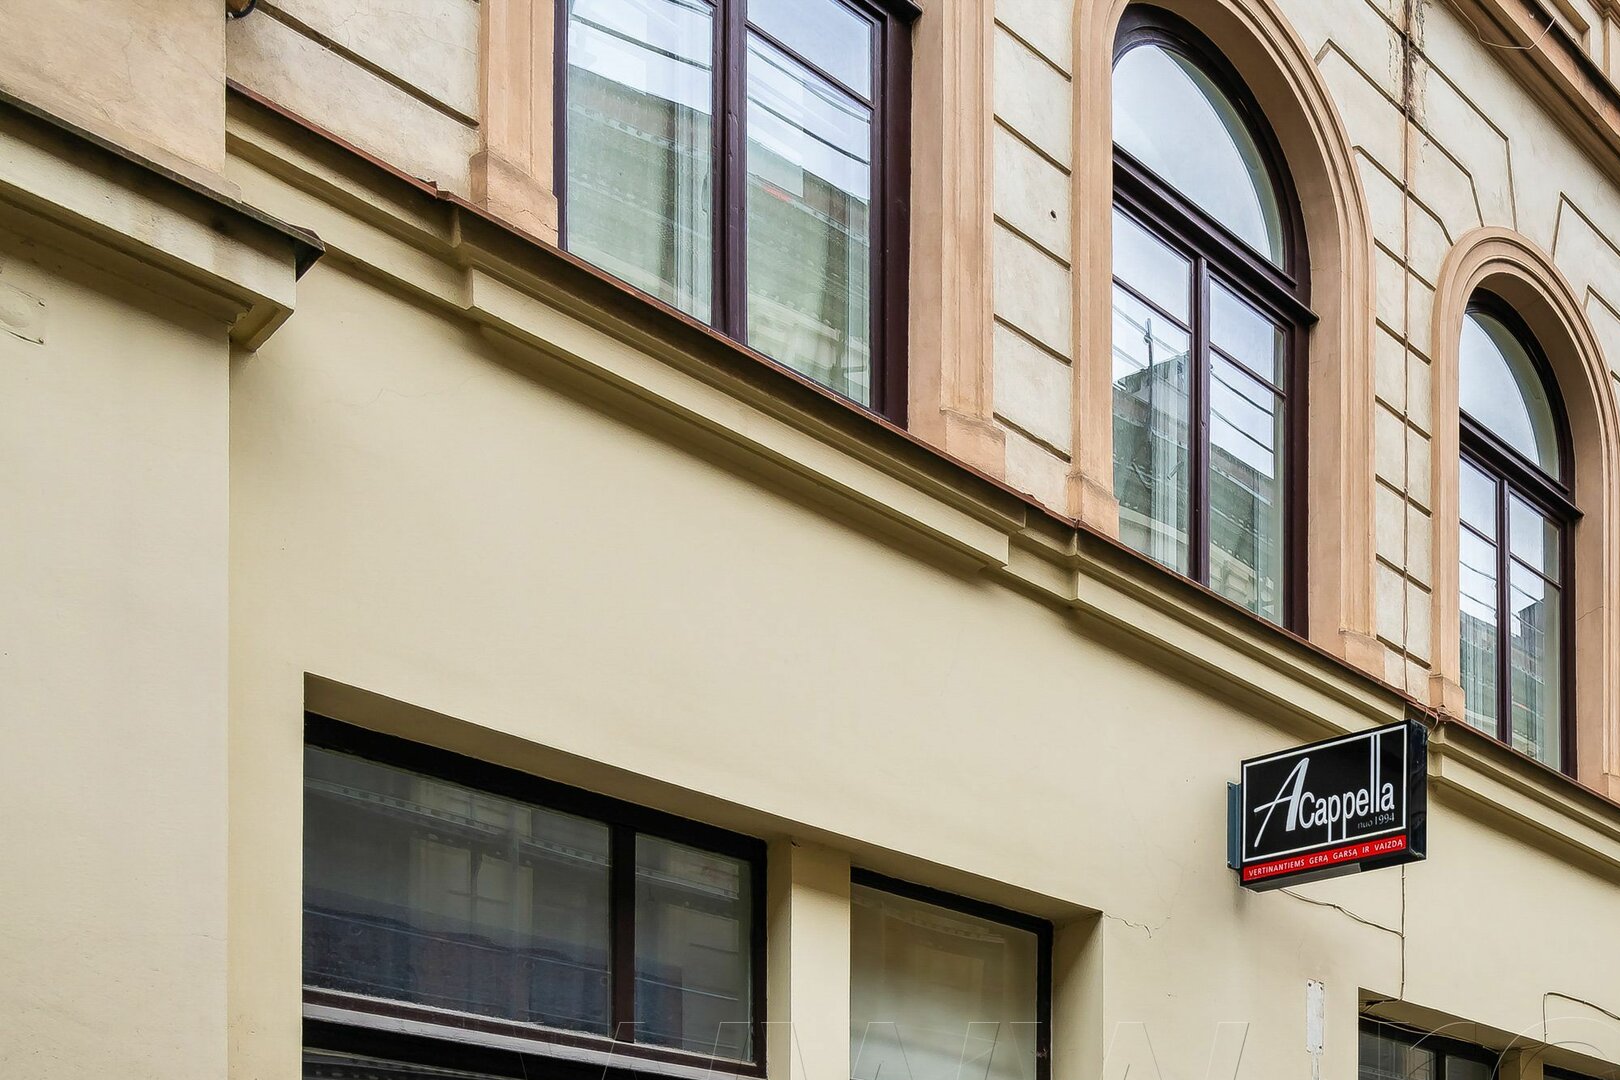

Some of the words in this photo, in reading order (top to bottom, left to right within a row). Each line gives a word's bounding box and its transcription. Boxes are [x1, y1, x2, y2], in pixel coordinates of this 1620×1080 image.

[1374, 812, 1395, 826] 1994
[1248, 858, 1305, 877] VERTINANTIEMS
[1332, 848, 1358, 860] GARSĄ
[1362, 845, 1370, 854] IR
